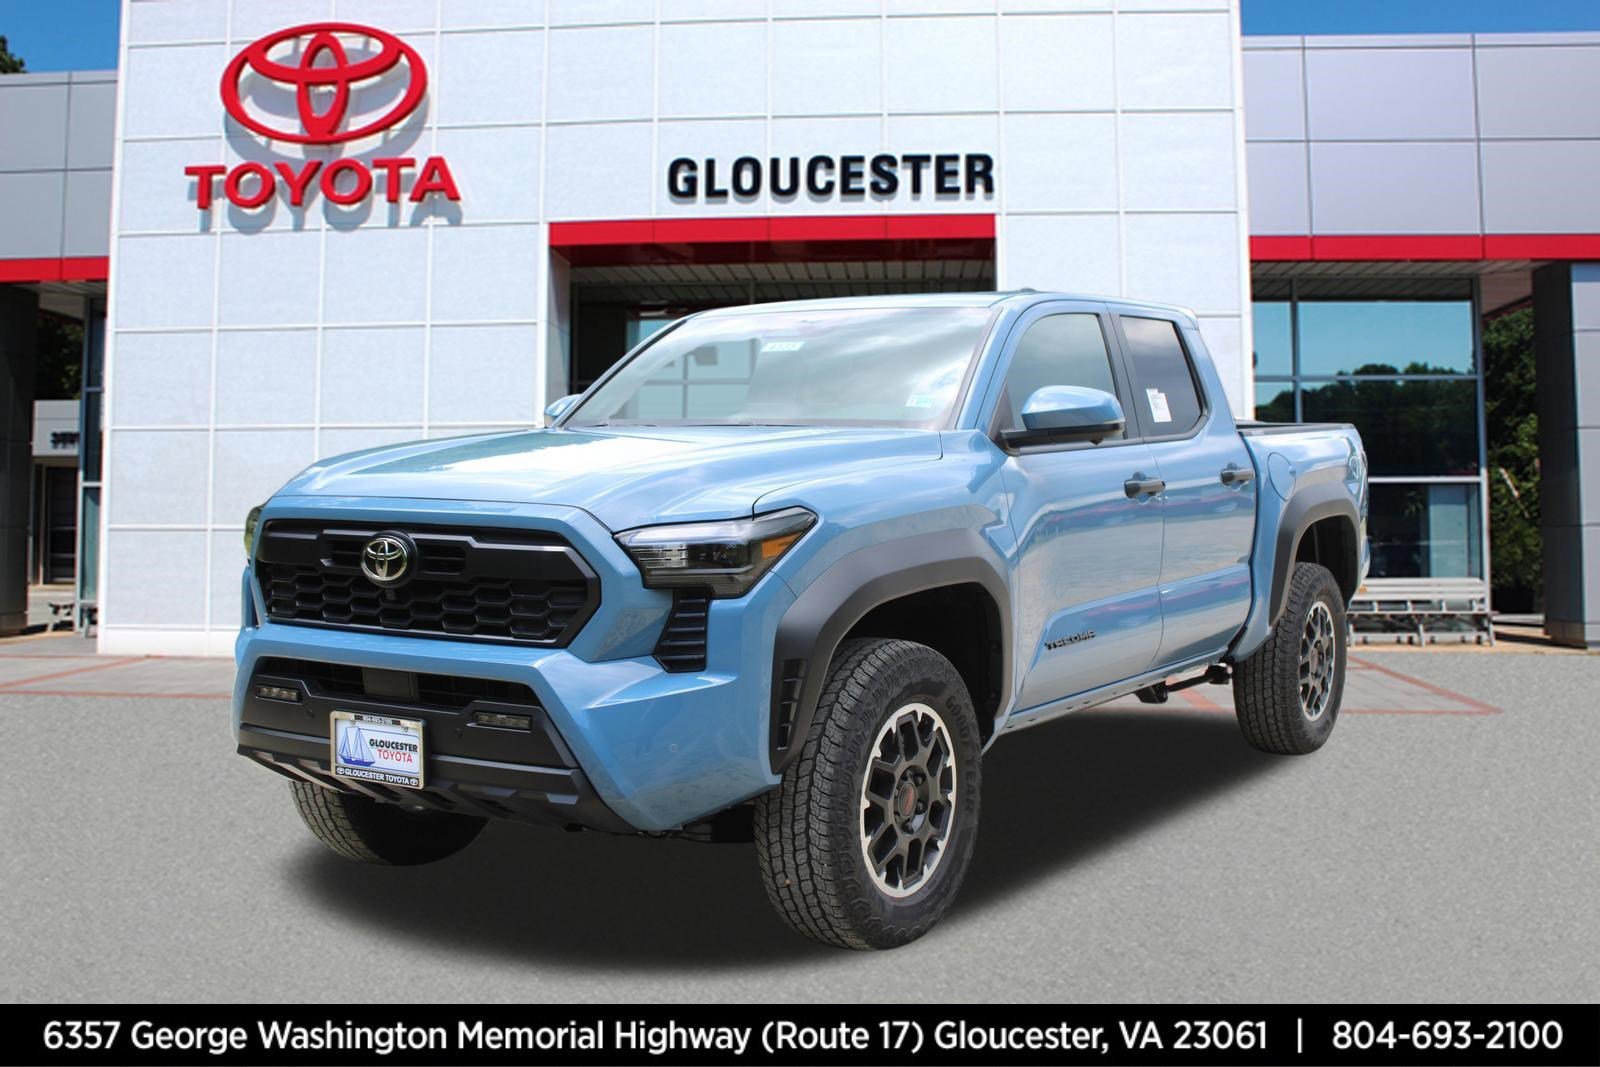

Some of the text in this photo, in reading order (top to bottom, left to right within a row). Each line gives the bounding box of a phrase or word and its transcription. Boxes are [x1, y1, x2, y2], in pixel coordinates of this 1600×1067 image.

[184, 155, 462, 211] TOYOTA
[667, 153, 995, 199] GLOUCESTER
[368, 738, 419, 753] GLOUCESTER
[376, 749, 414, 764] TOYOTA
[344, 768, 410, 785] GLOUCESTER TOYOTA
